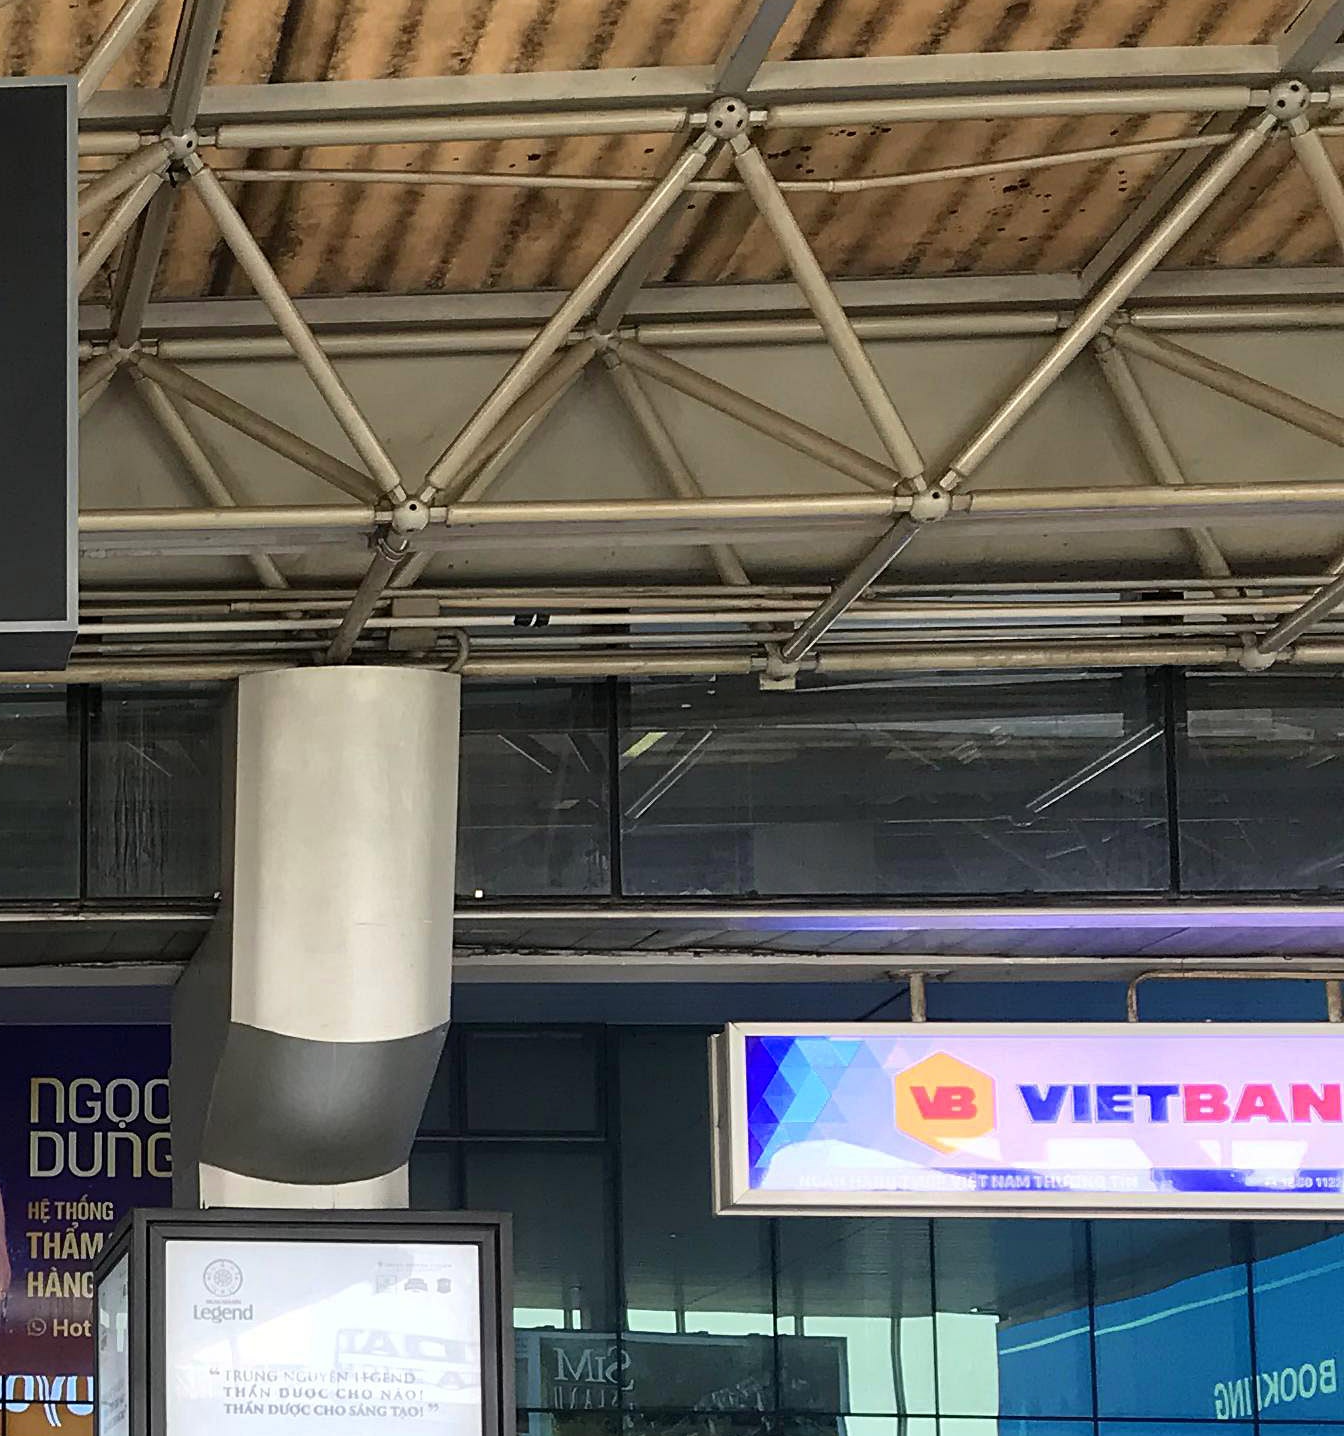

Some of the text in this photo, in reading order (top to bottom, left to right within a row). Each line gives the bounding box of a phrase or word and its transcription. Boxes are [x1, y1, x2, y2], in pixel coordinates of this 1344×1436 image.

[1016, 1083, 1344, 1124] VIETBAN
[28, 1194, 114, 1221] HỆ THỐNG
[193, 1304, 253, 1324] Legend
[313, 1404, 346, 1416] CHO
